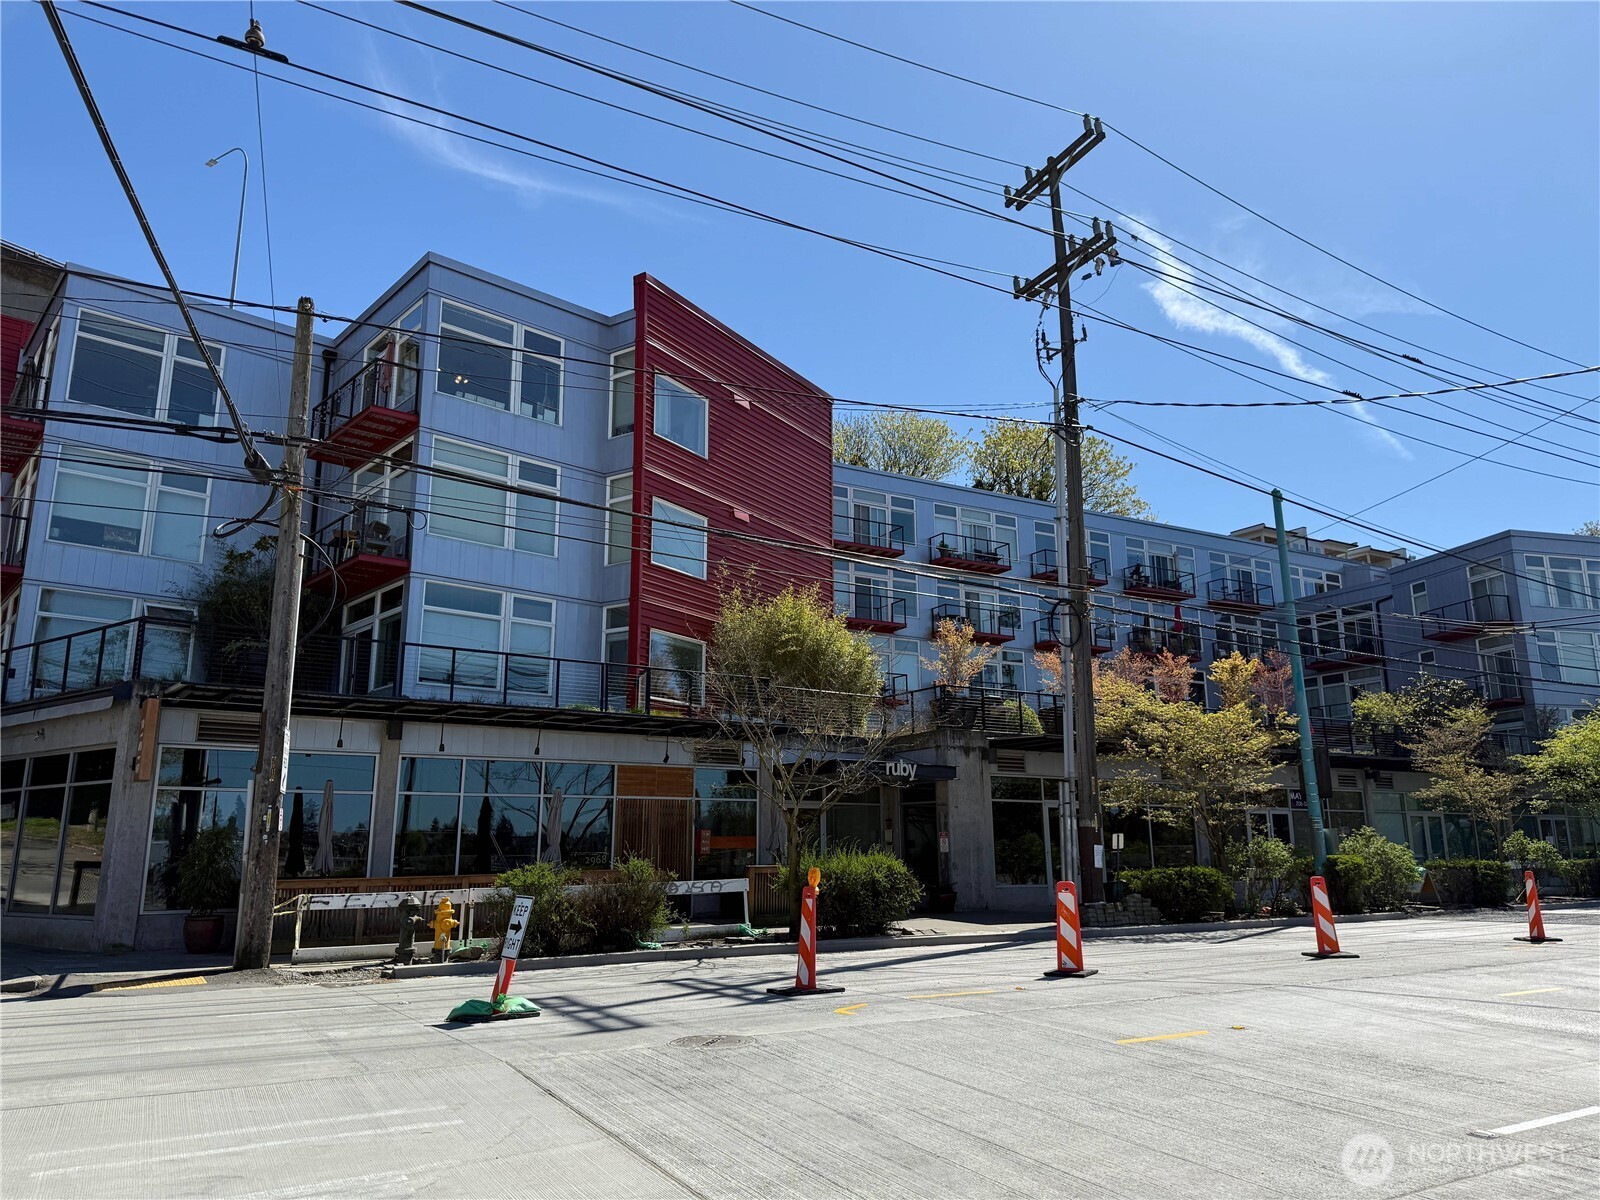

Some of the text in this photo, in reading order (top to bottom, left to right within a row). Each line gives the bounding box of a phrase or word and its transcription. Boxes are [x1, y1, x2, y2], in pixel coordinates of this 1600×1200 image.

[885, 759, 918, 781] ruby
[585, 854, 607, 867] 2968
[513, 904, 529, 917] KEEP
